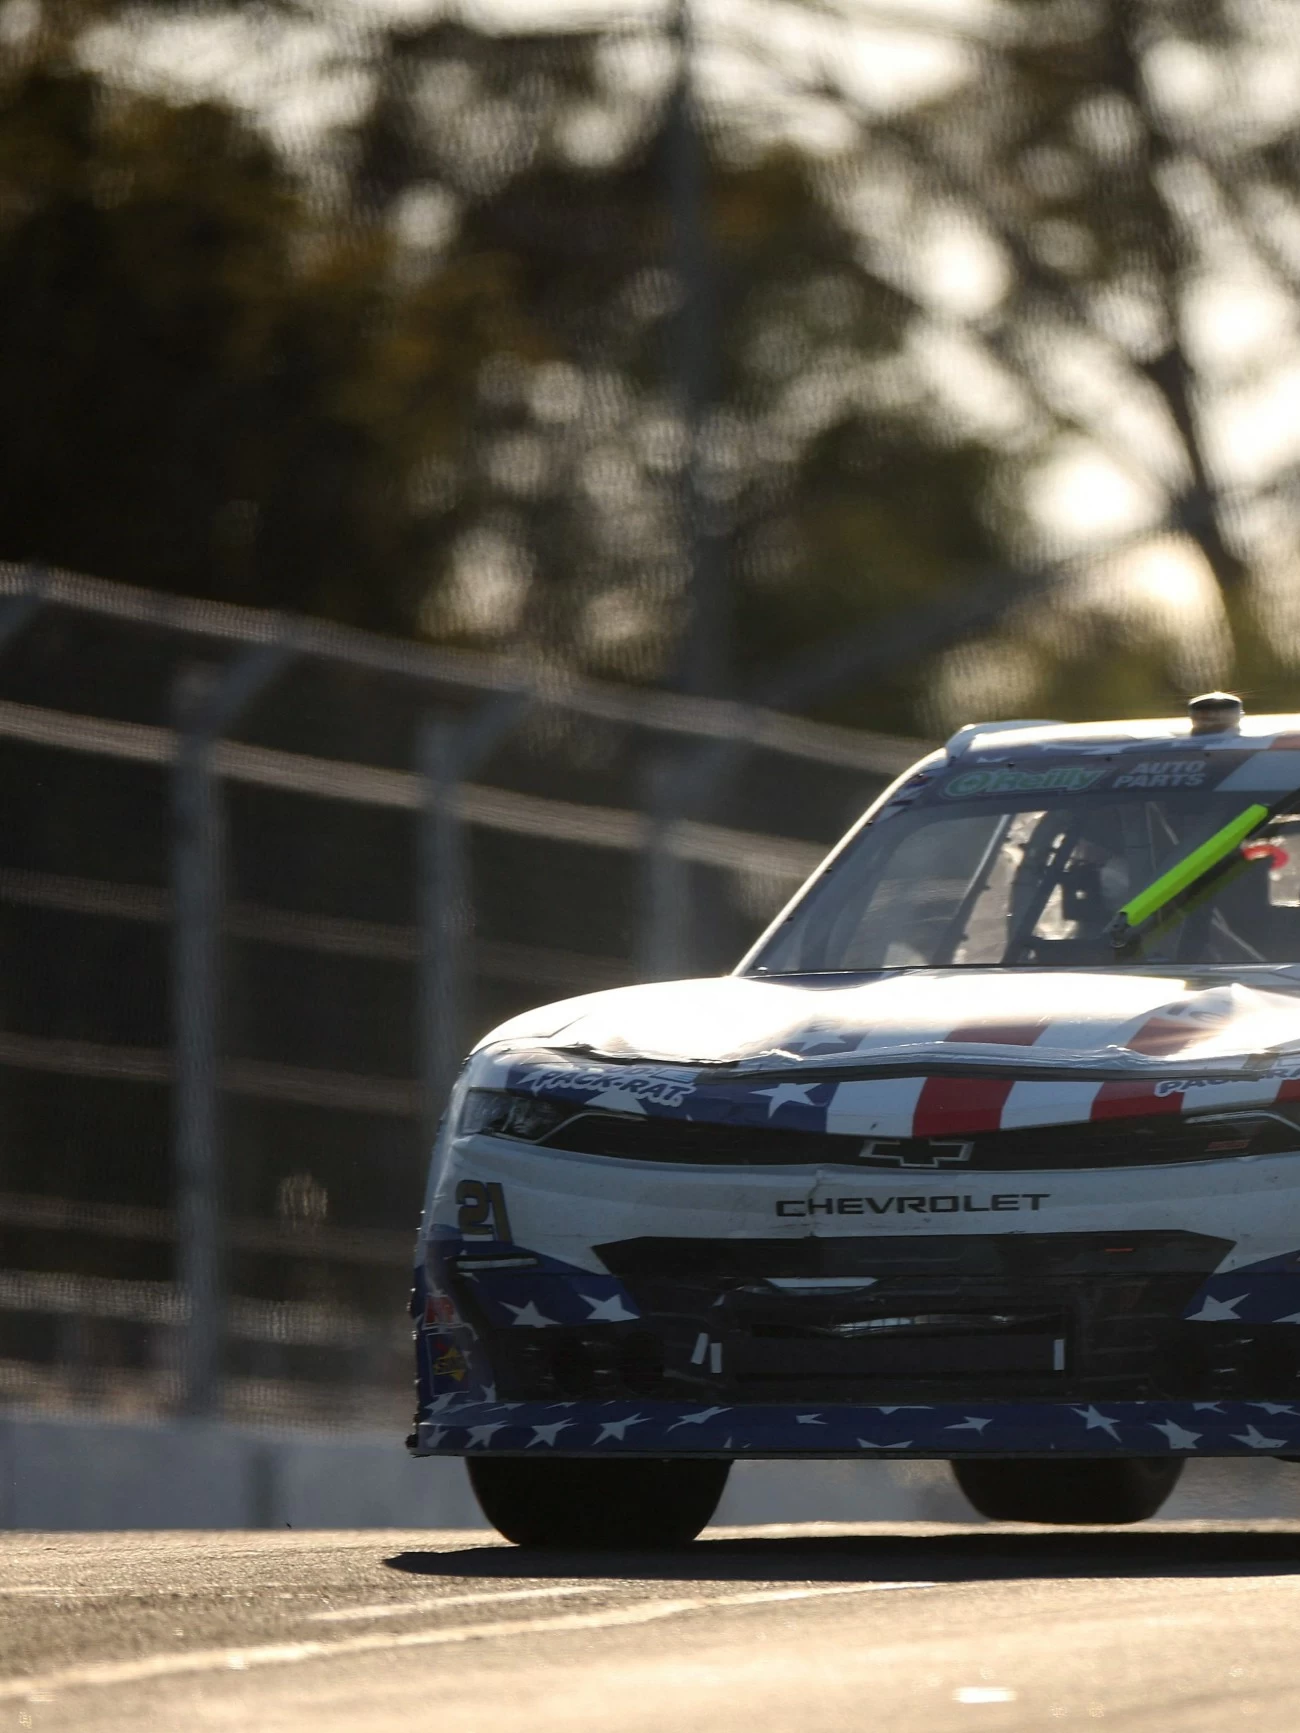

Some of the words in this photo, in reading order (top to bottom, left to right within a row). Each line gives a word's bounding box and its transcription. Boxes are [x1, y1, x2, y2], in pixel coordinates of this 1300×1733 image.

[1129, 760, 1207, 775] AUTO
[1112, 773, 1206, 788] PARTS
[456, 1179, 513, 1245] 21
[776, 1193, 1051, 1217] CHEVROLET
